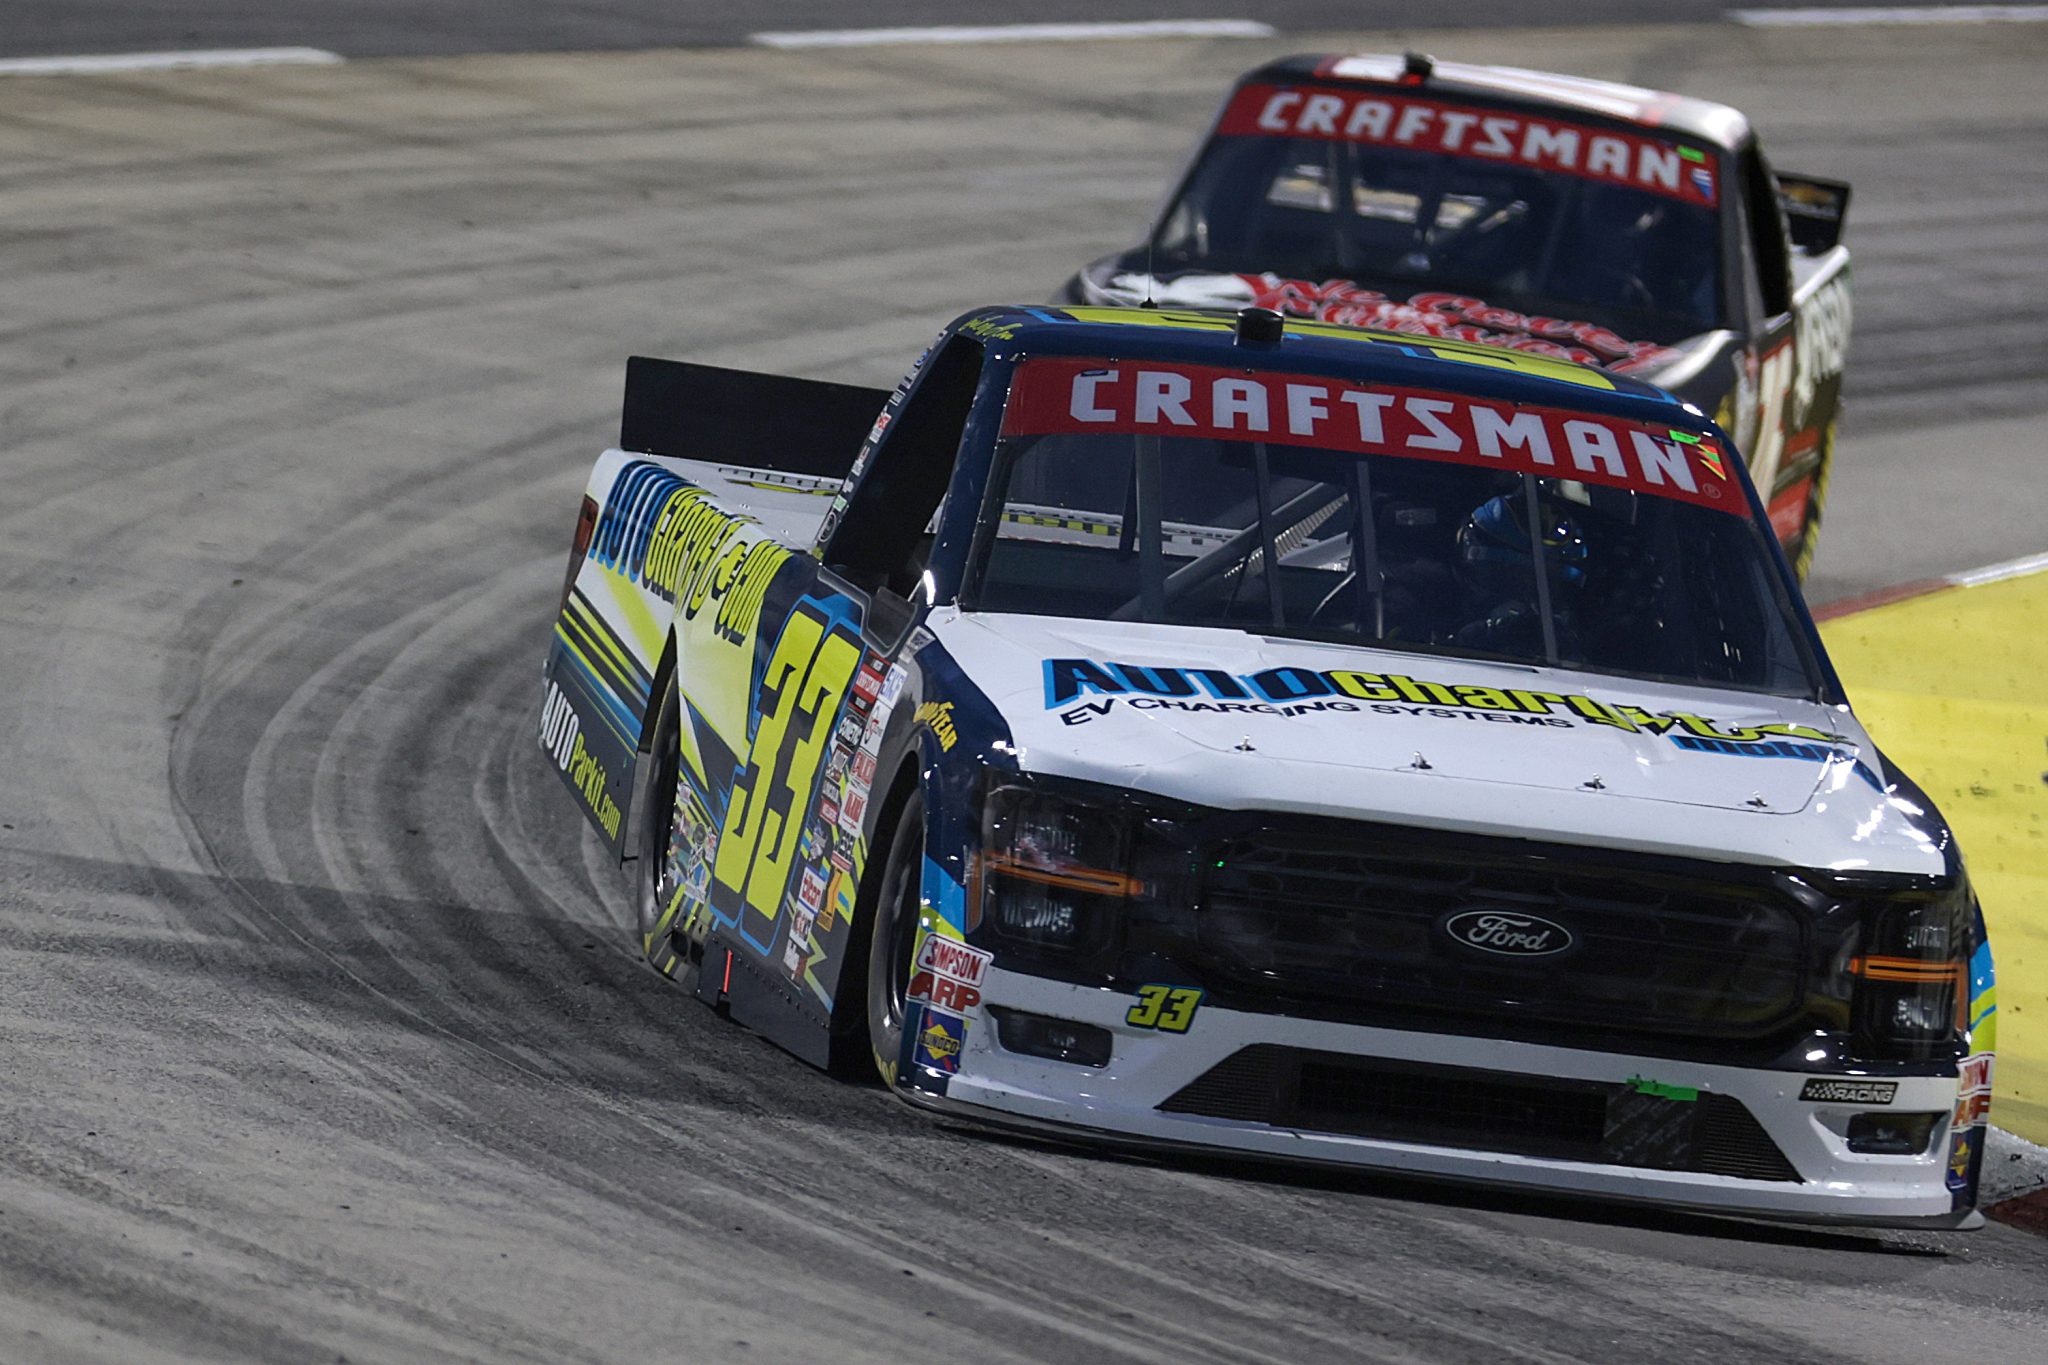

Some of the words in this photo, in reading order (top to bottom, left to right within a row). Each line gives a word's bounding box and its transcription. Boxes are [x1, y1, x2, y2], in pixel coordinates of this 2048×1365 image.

[1257, 91, 1682, 193] CRAFTSMAN
[1069, 370, 1699, 494] CRAFTSMAN
[1060, 698, 1115, 726] EV
[1128, 698, 1361, 718] CHARGING
[1369, 703, 1576, 729] SYSTEMS
[713, 608, 862, 922] 33
[1467, 914, 1551, 953] Ford
[924, 940, 983, 981] SIMPSON
[908, 971, 982, 1013] ARP
[1126, 983, 1204, 1034] 33
[1836, 1088, 1894, 1103] RACING
